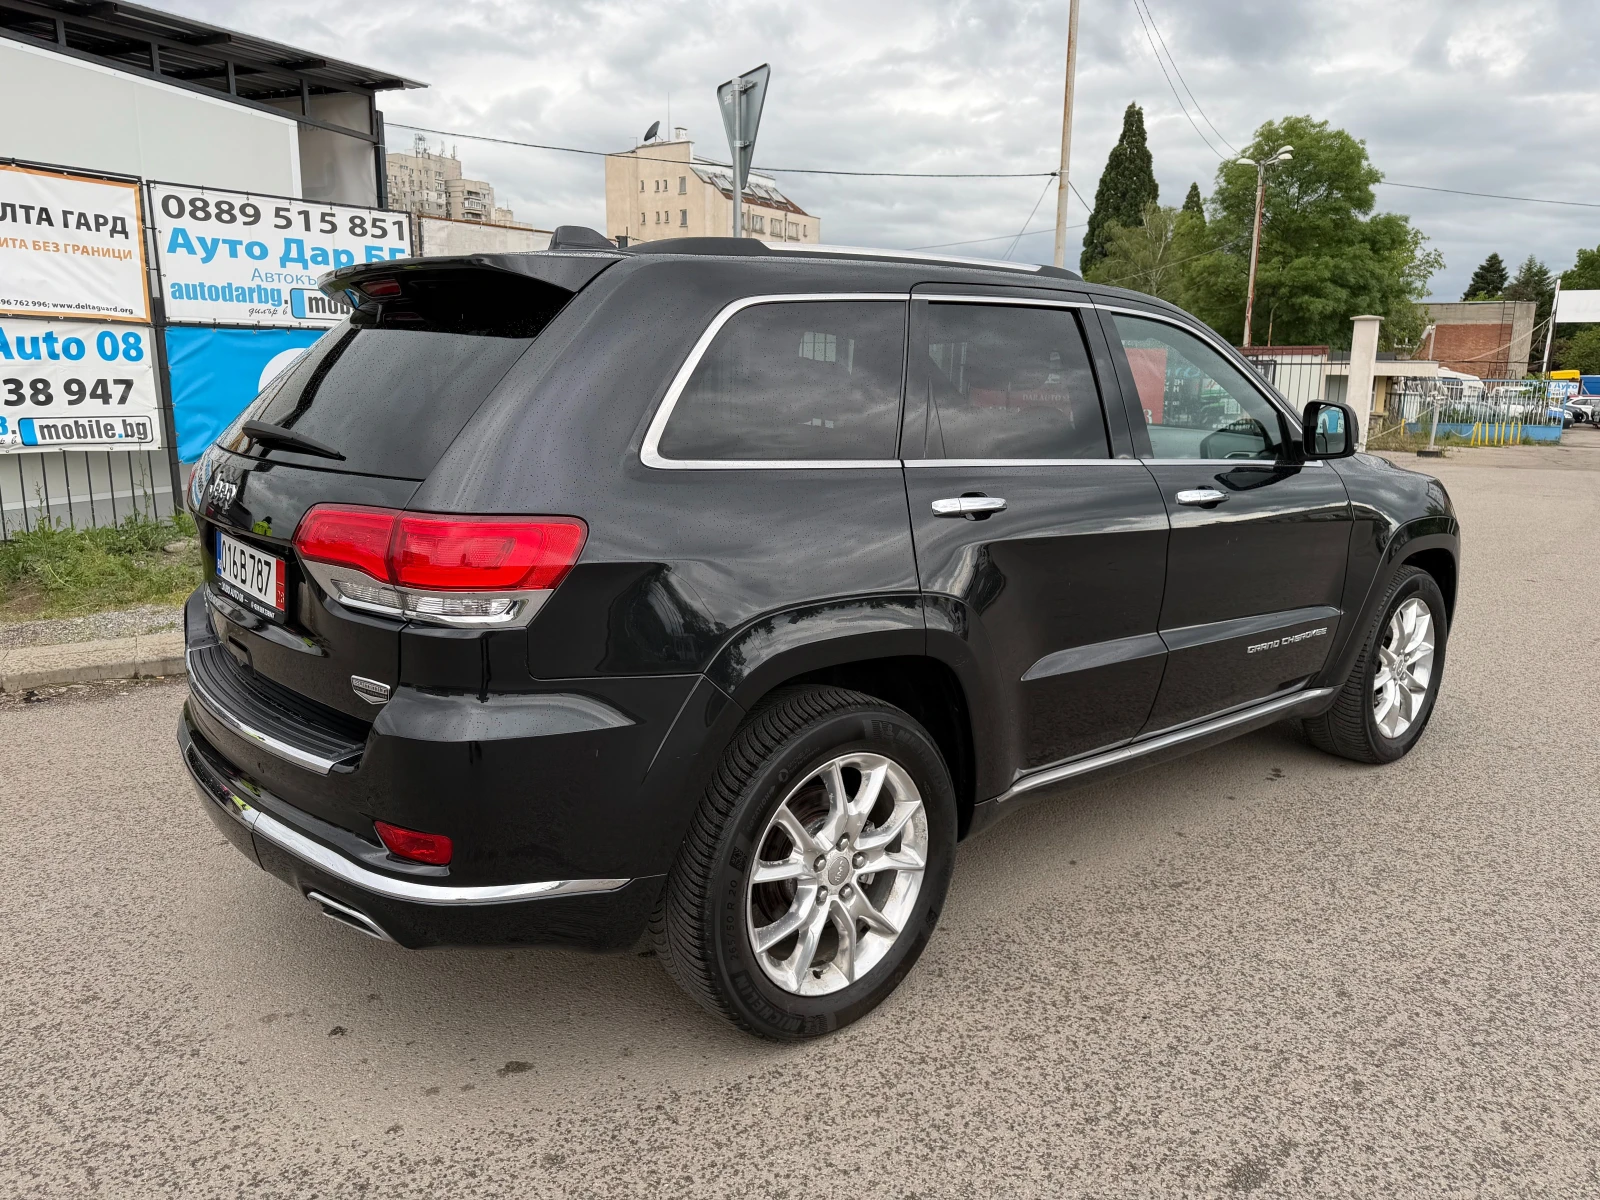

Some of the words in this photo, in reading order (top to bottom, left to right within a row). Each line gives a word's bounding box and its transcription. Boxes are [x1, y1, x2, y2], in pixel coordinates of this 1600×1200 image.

[61, 209, 129, 240] ГАРД
[161, 194, 261, 226] 0889
[273, 206, 338, 234] 515
[348, 215, 405, 241] 851
[32, 239, 60, 253] БЕЗ
[63, 243, 133, 261] ГРАНИЦИ
[166, 227, 269, 265] Ауто
[279, 237, 355, 271] Дар
[13, 299, 30, 307] 762
[52, 302, 134, 315] www.deltaguard.org
[96, 330, 144, 362] 08
[2, 378, 54, 407] 38
[63, 378, 134, 406] 947
[39, 418, 149, 440] mobile.bg
[1247, 639, 1280, 654] GRAND
[729, 879, 738, 897] 20
[725, 915, 739, 961] 265/50
[734, 975, 802, 1032] MICHELIN
